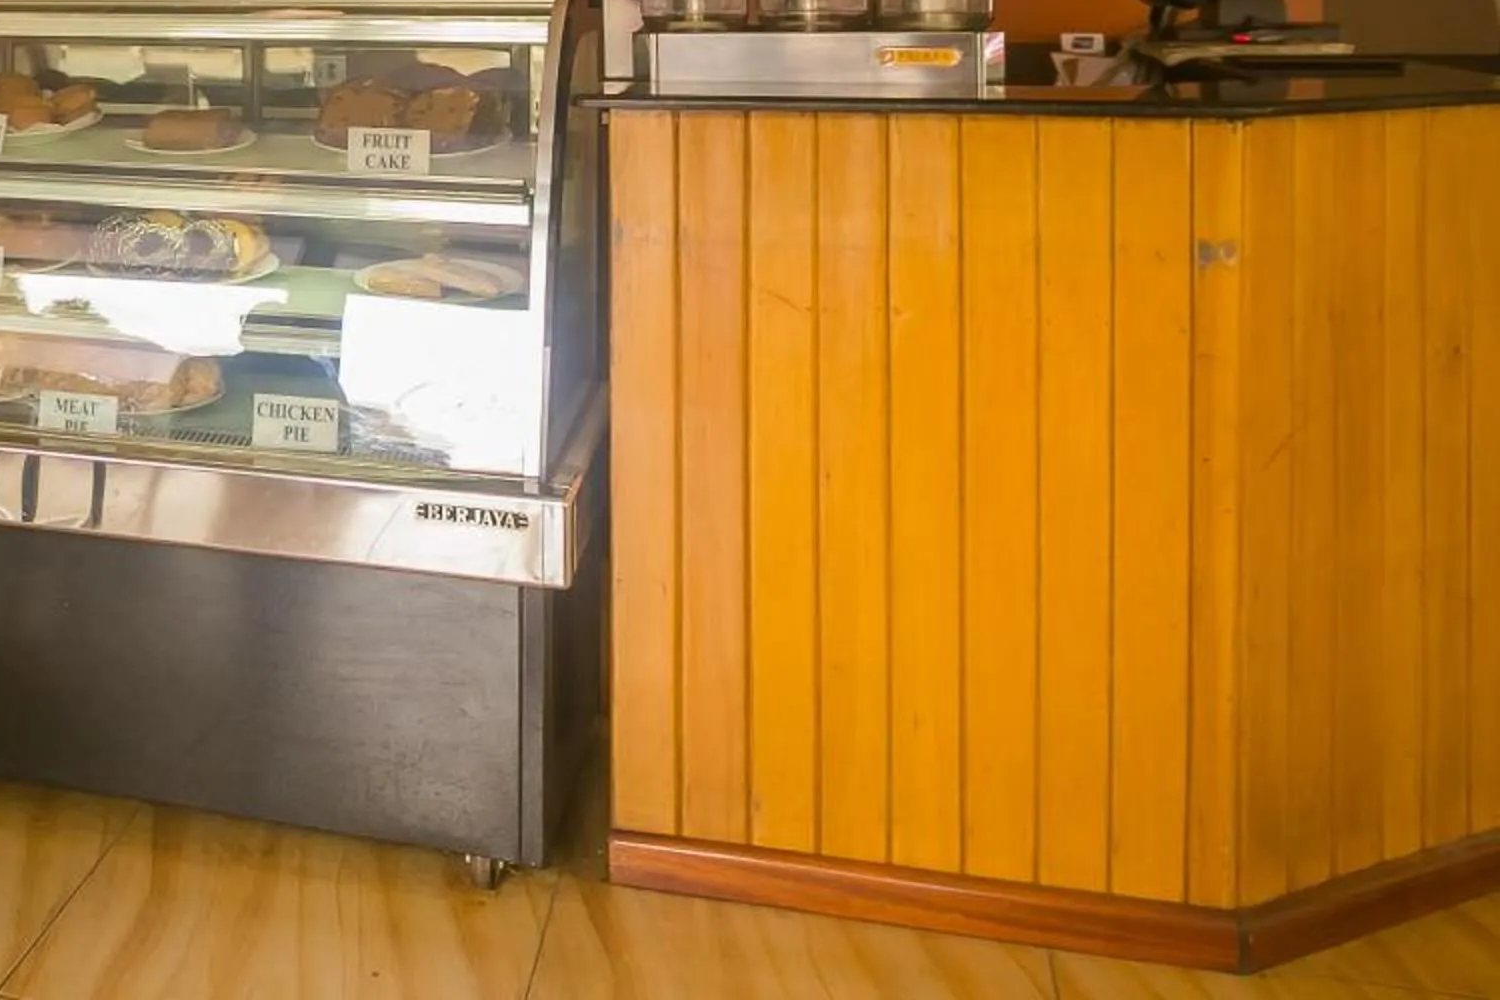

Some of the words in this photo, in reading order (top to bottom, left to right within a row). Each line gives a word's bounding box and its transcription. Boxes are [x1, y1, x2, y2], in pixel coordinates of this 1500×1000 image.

[362, 133, 412, 149] FRUIT
[365, 153, 411, 170] CAKE
[54, 397, 101, 416] MEAT
[257, 401, 336, 422] CHICKEN
[284, 426, 310, 442] PIE
[423, 503, 519, 528] BERJAYA
